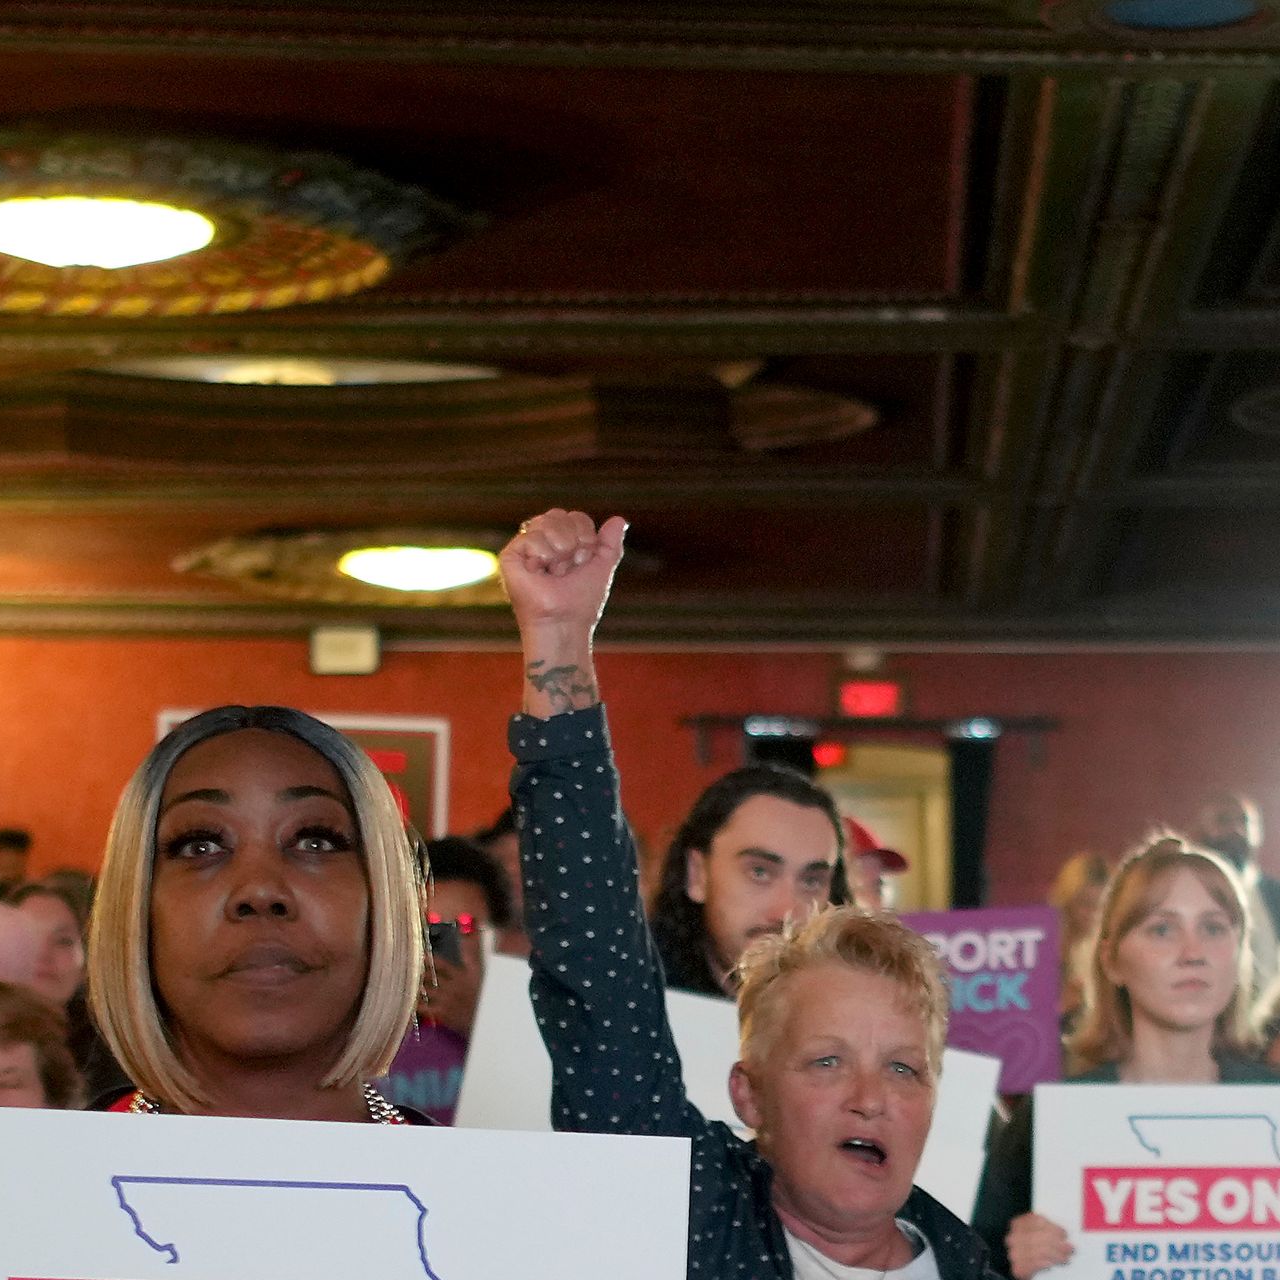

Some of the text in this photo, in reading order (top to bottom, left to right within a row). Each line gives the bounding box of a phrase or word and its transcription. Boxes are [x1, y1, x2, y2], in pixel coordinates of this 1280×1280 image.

[949, 973, 1031, 1013] ICK
[1092, 1176, 1200, 1226] YES
[1105, 1243, 1159, 1263] END
